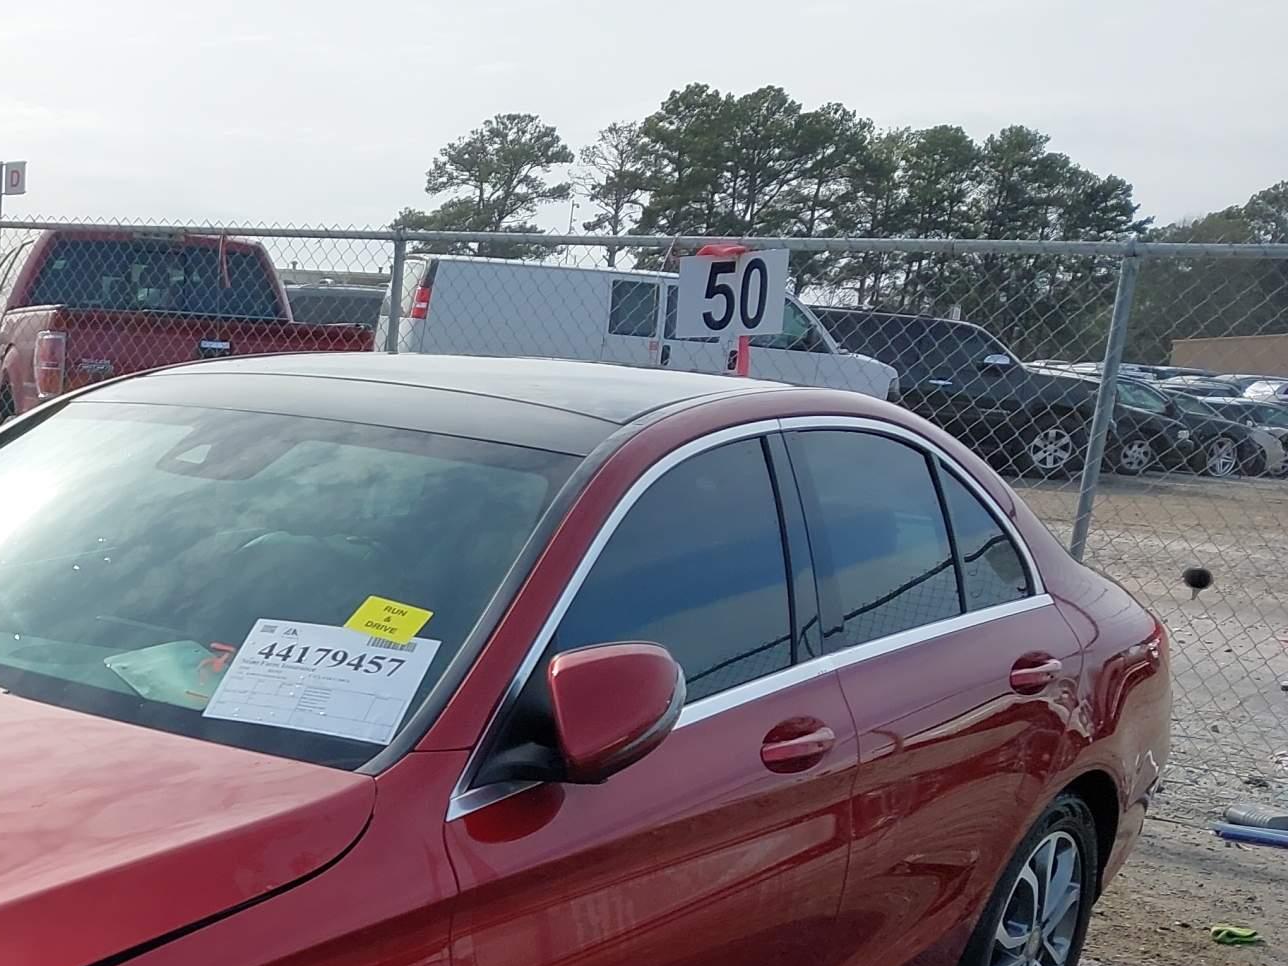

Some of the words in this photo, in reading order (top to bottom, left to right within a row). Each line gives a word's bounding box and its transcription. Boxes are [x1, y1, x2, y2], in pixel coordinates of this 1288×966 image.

[10, 169, 20, 188] D
[702, 258, 768, 331] 50
[383, 605, 409, 617] RUN
[364, 620, 398, 635] DRIVE
[257, 641, 407, 678] 44179457
